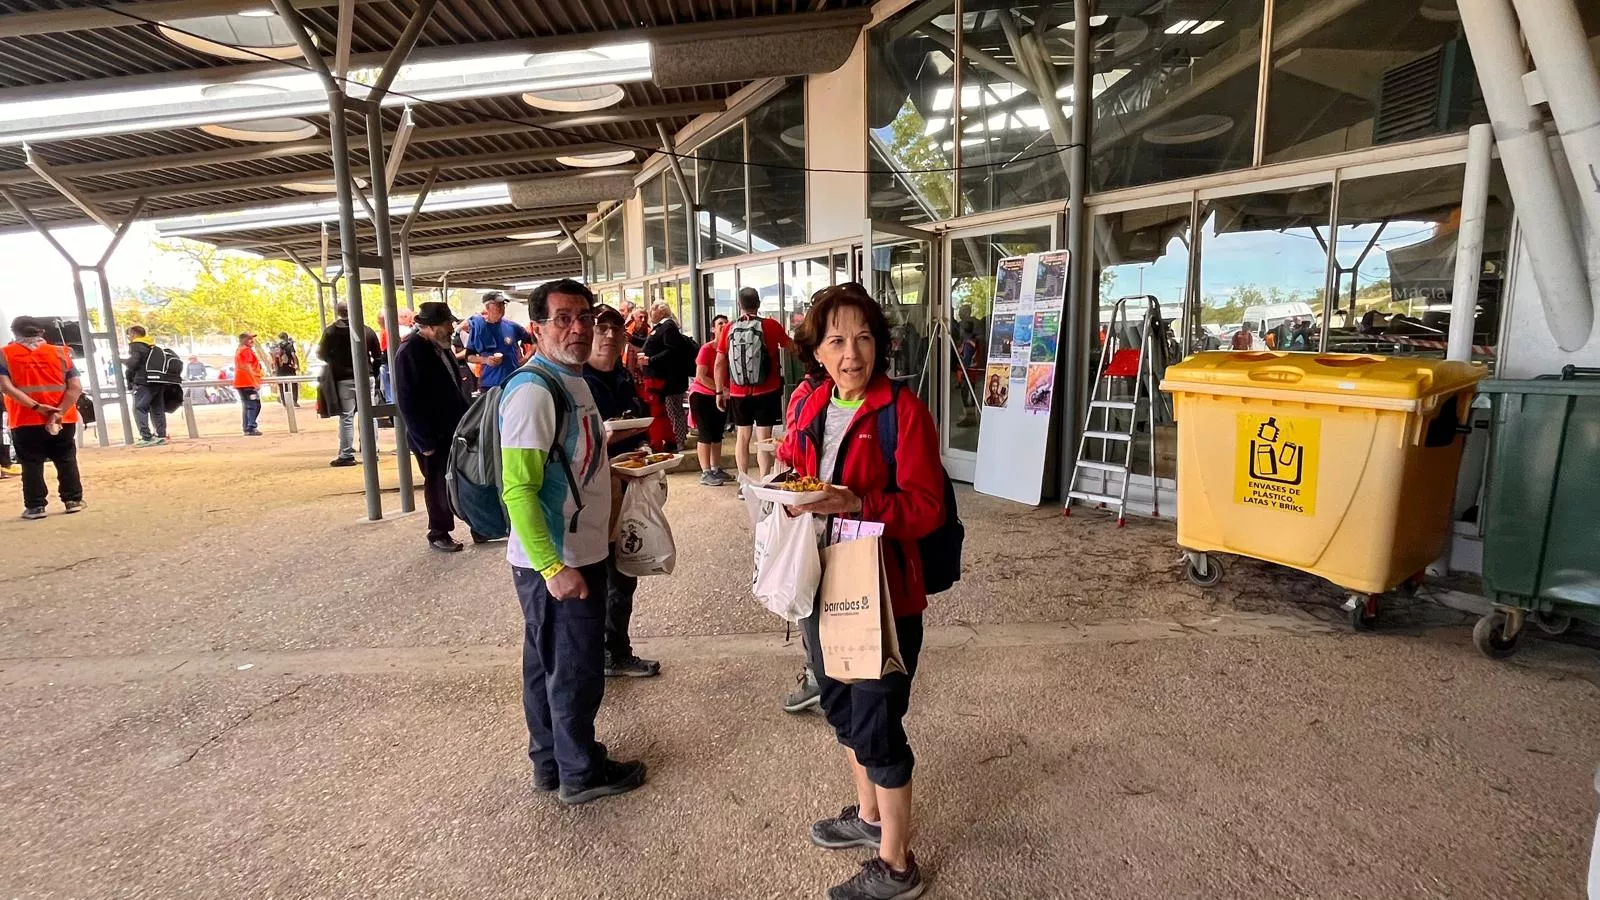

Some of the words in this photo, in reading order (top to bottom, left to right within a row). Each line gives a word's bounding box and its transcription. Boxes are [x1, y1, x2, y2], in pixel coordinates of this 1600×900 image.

[1248, 482, 1287, 492] ENVASES
[1243, 497, 1268, 505] LATAS
[1279, 503, 1303, 512] BRIKS
[824, 598, 860, 612] barrabes
